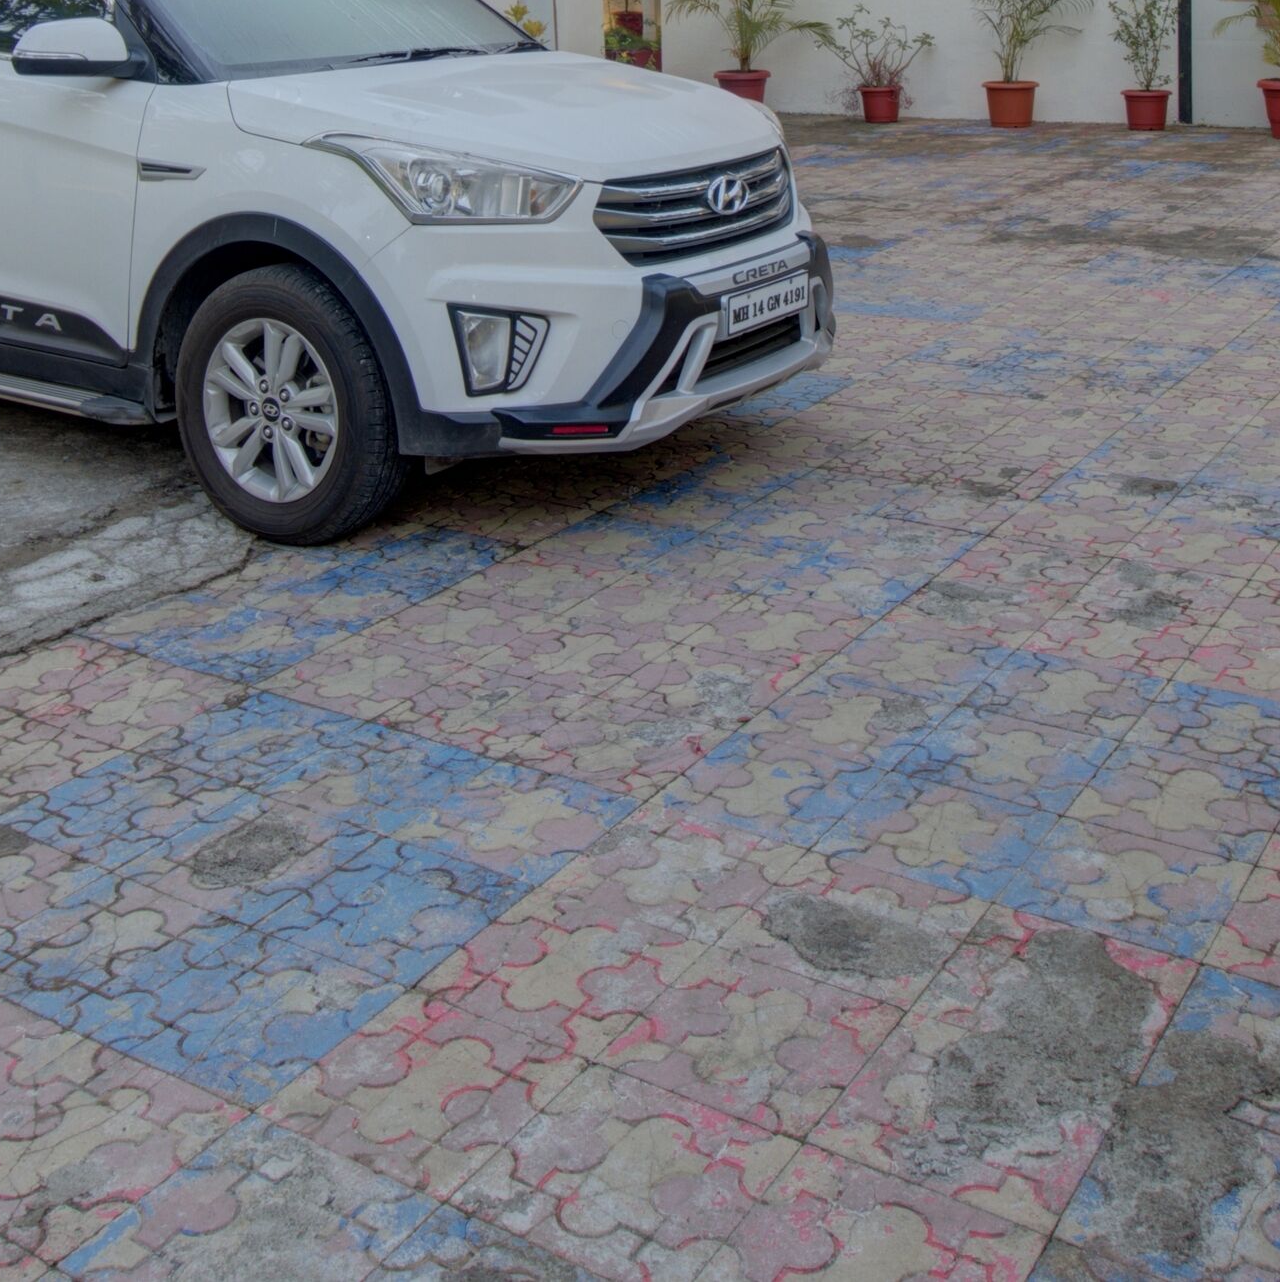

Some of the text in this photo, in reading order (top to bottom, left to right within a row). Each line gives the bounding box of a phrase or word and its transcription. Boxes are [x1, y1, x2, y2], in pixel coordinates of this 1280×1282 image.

[732, 259, 788, 285] CRETA
[733, 286, 805, 325] MH 14 GN 4191
